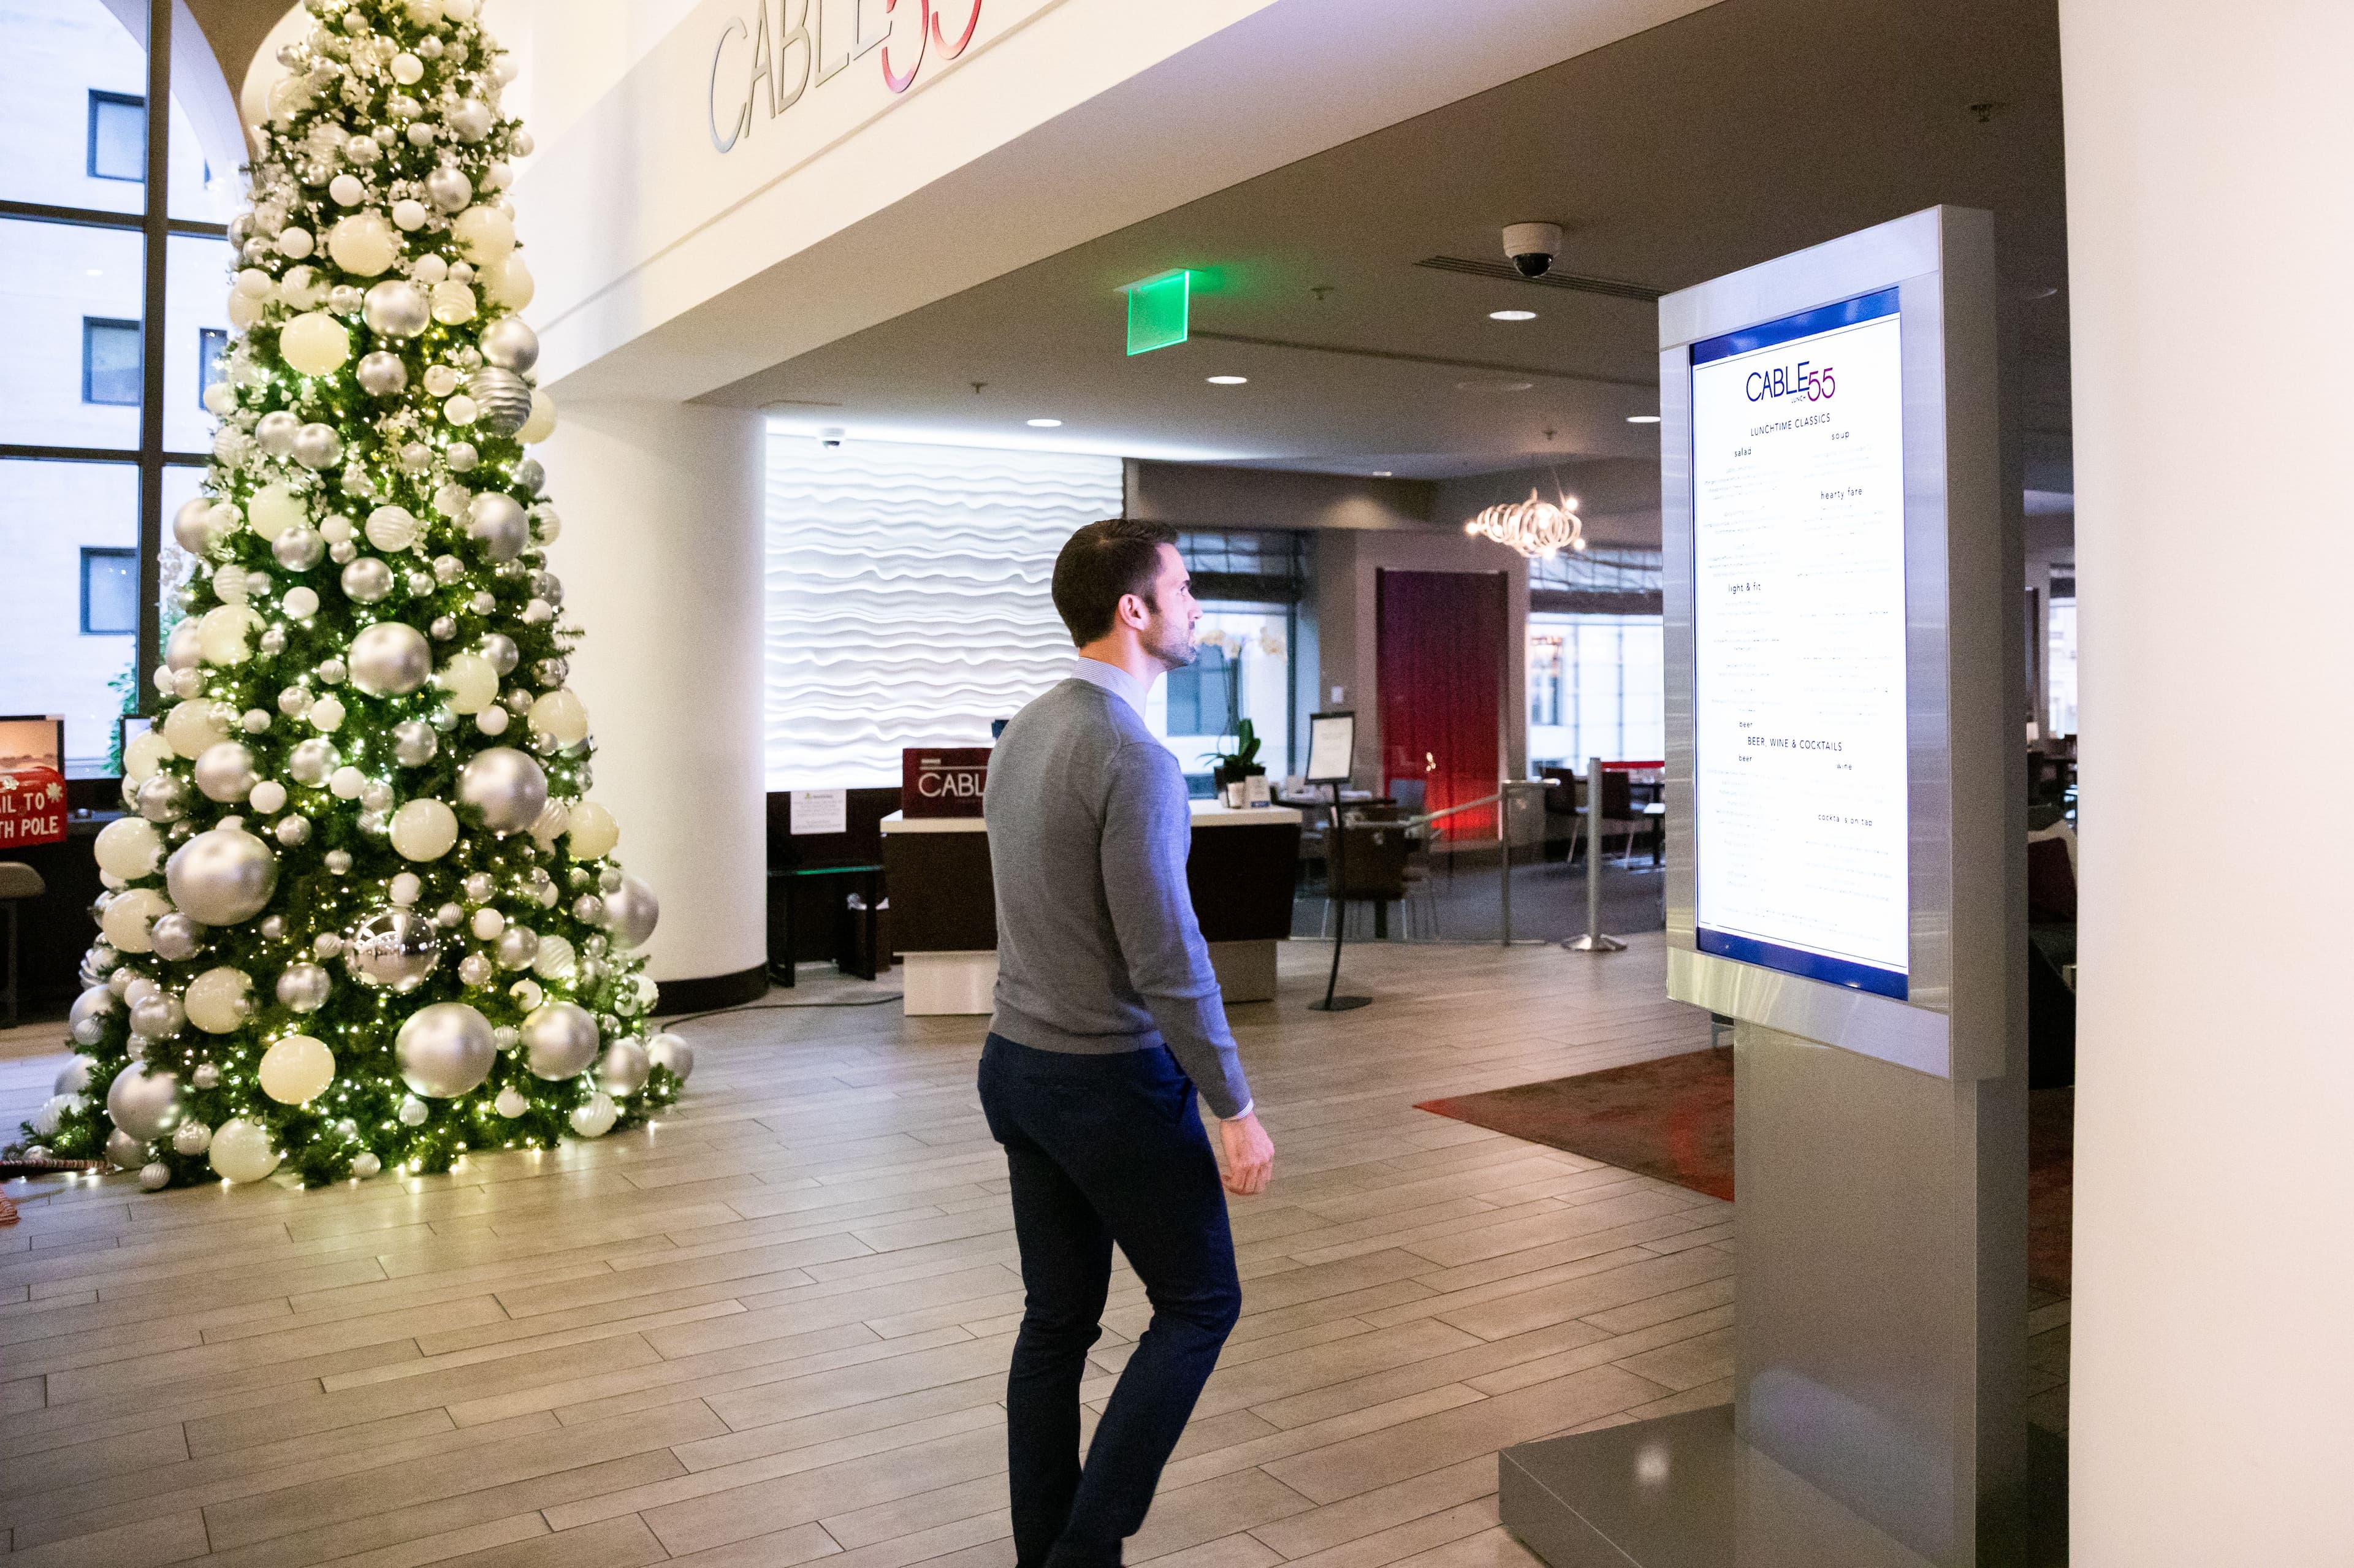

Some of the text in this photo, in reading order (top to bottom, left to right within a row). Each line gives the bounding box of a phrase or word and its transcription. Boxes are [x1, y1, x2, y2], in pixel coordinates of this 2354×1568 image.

[1746, 360, 1835, 402] CABLE55
[1751, 413, 1830, 436] LUNCHTIME CLASSICS
[1831, 431, 1850, 441] soup
[1734, 447, 1751, 457] salad
[1821, 487, 1862, 500] hearty fare
[1728, 583, 1743, 595] light
[1746, 582, 1751, 592] &
[1748, 736, 1842, 752] BEER, WINE & COCKTAILS
[1739, 753, 1752, 762] beer
[918, 772, 985, 797] CABL
[0, 792, 45, 813] IL TO
[1818, 813, 1848, 823] cocktas
[21, 816, 59, 837] POLE
